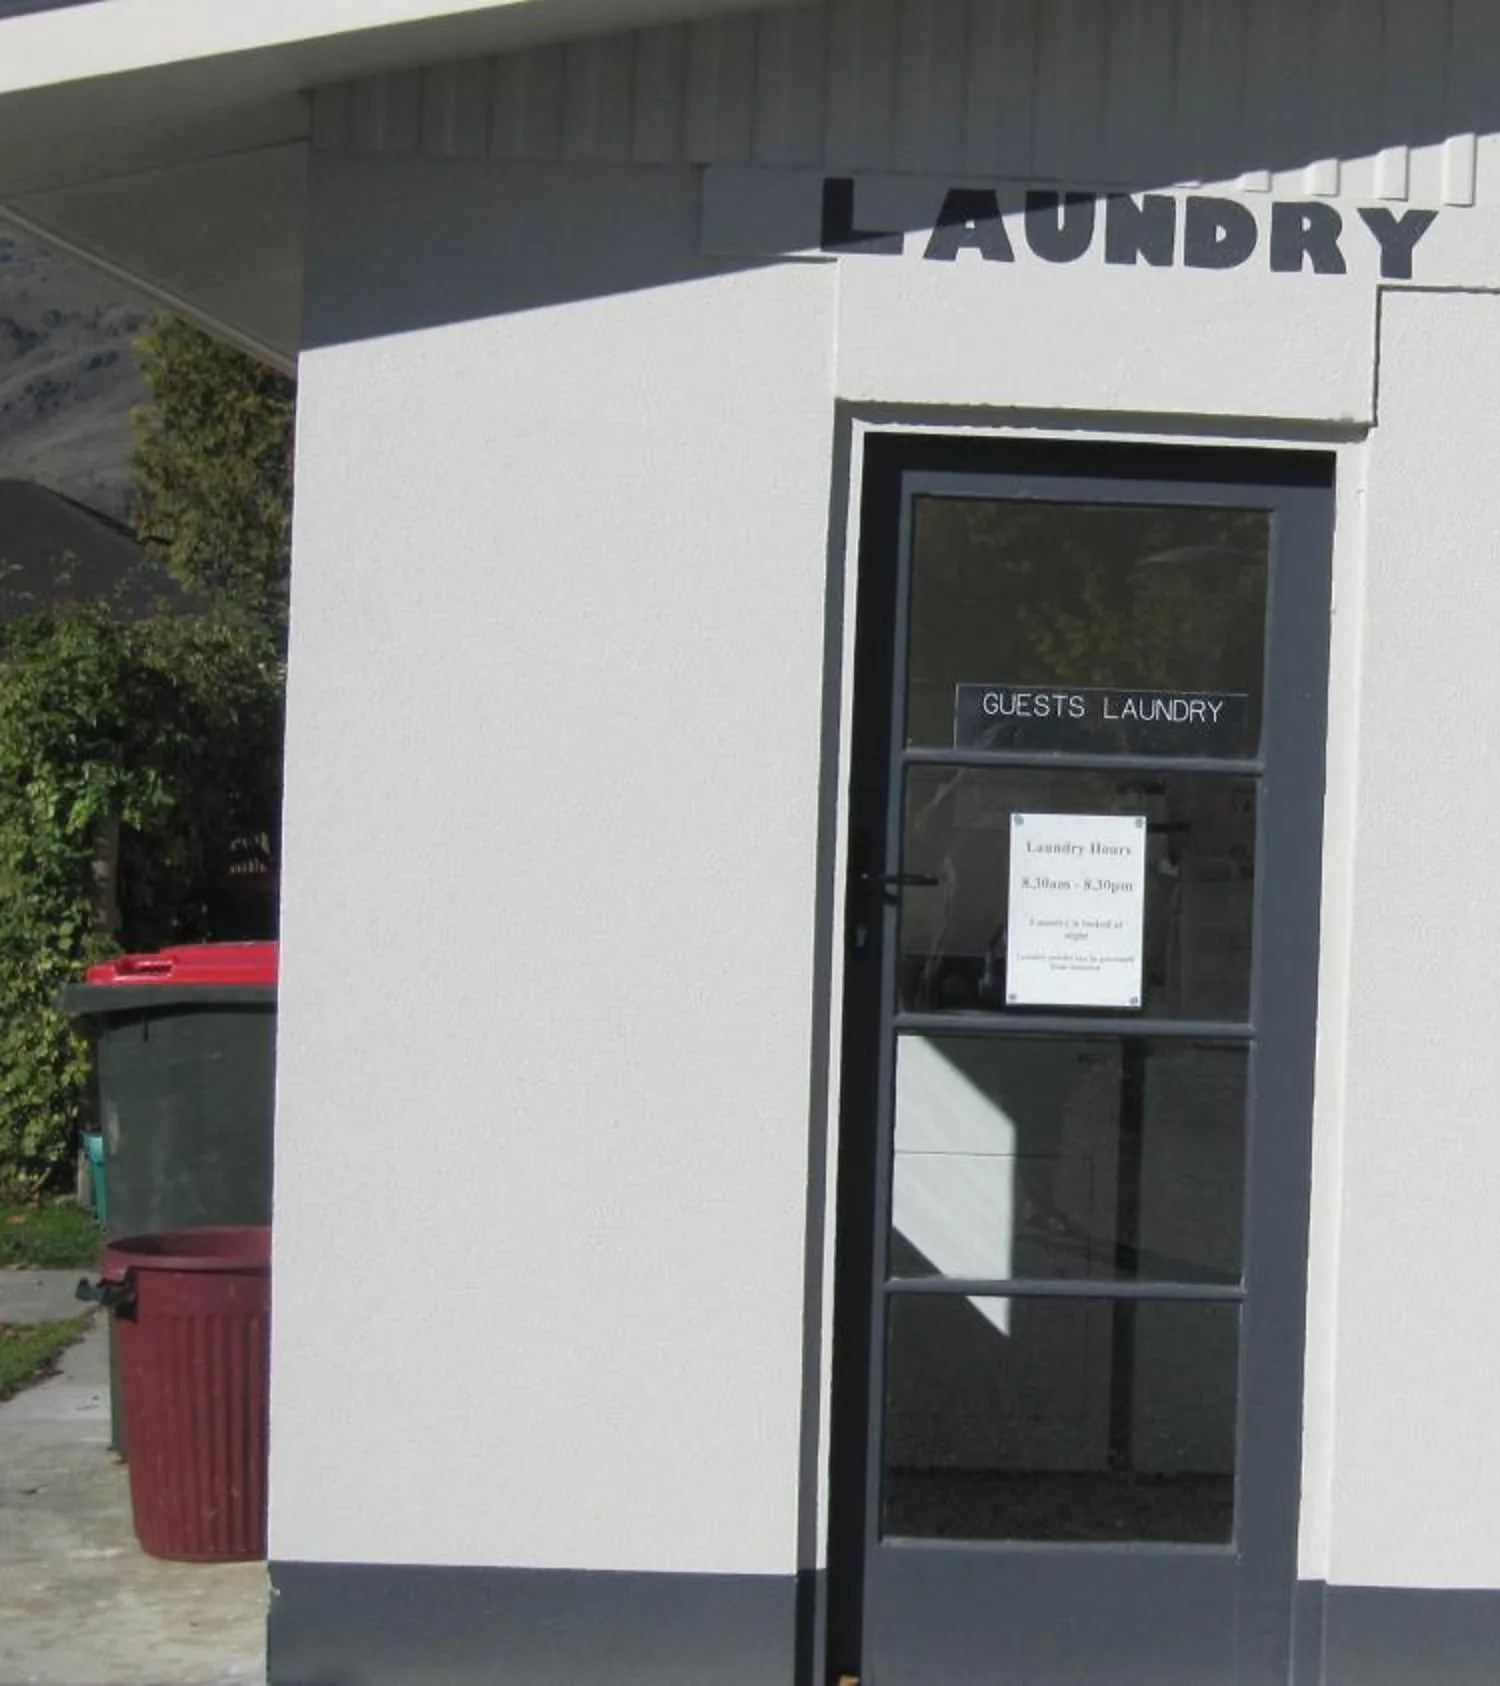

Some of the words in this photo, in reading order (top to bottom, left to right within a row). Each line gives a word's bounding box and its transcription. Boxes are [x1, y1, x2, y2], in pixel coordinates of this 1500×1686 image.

[820, 177, 1439, 280] LAUNDRY
[983, 692, 1085, 718] GUESTS
[1103, 696, 1223, 722] LAUNDRY
[1026, 840, 1084, 857] Laundry
[1090, 841, 1132, 856] Hours
[1021, 876, 1071, 890] 8.30am
[1084, 878, 1133, 893] 8.30pm
